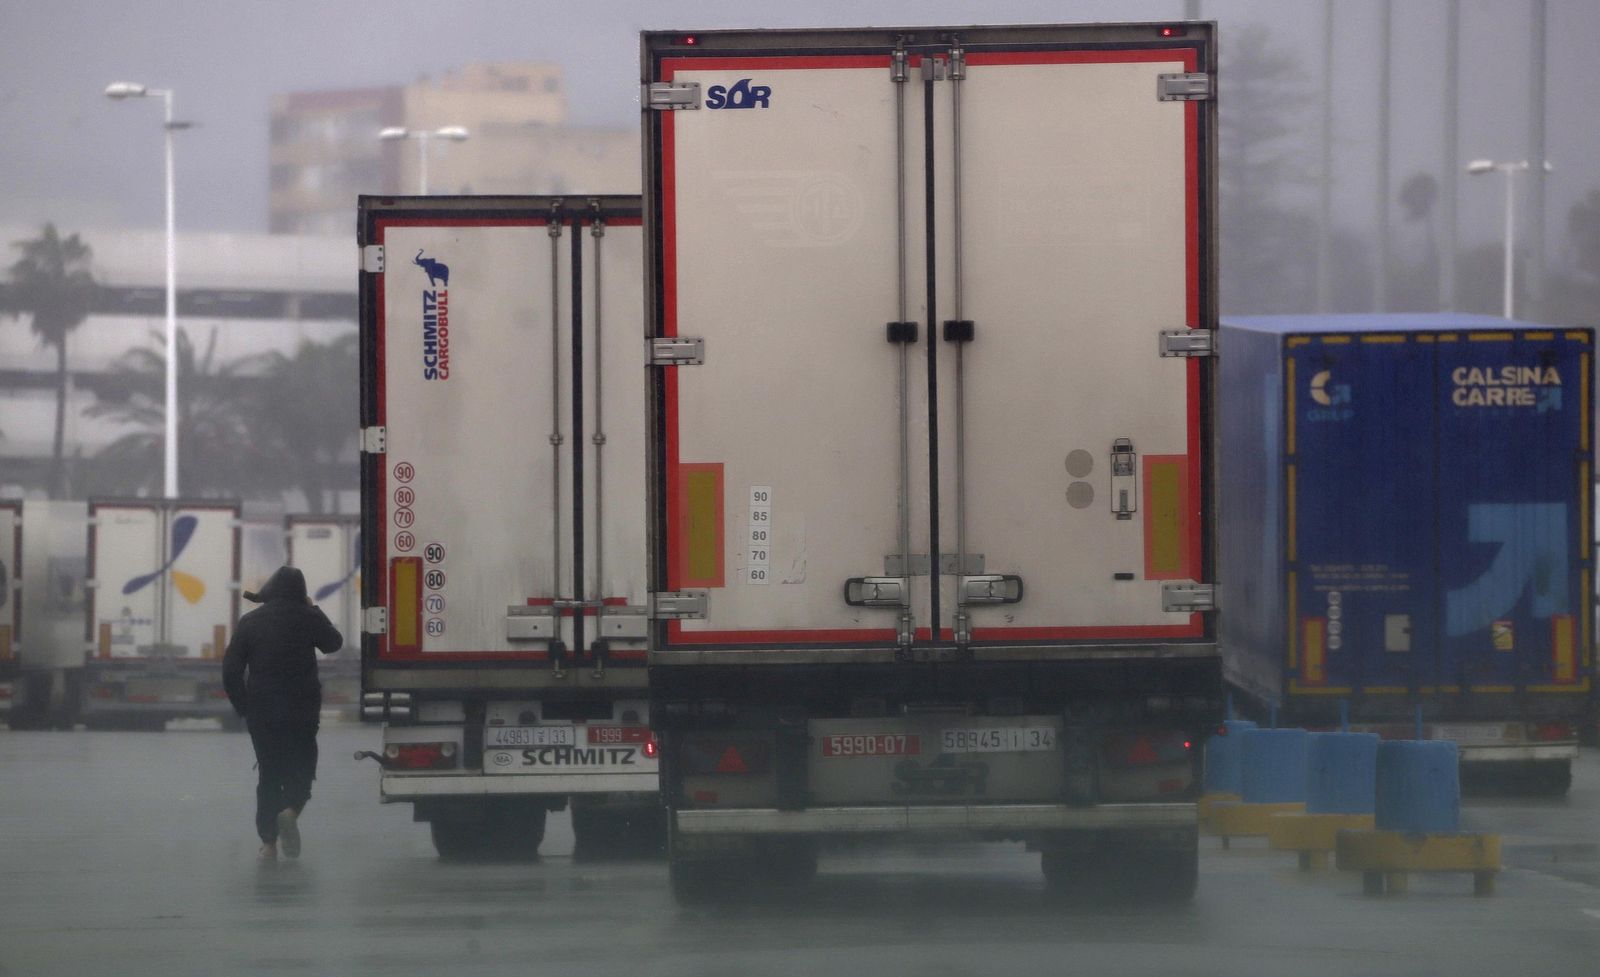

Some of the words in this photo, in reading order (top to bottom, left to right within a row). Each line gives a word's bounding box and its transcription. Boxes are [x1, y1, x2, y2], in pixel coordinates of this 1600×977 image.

[423, 290, 438, 380] SCHMITZ
[438, 289, 449, 381] CARGOBULL
[1451, 366, 1561, 385] CALSINA
[397, 466, 411, 479] 90
[397, 490, 411, 504] 80
[754, 491, 768, 502] 90
[398, 511, 411, 524] 70
[753, 511, 768, 521] 85
[398, 535, 412, 548] 60
[752, 531, 767, 541] 80
[427, 547, 442, 560] 90
[751, 550, 766, 561] 70
[428, 573, 442, 587] 80
[751, 570, 765, 580] 60
[429, 598, 443, 610] 70
[428, 621, 443, 633] 60
[552, 729, 566, 744] 33
[595, 728, 622, 743] 1999
[1030, 730, 1051, 748] 34
[831, 735, 906, 755] 5990-07
[522, 748, 636, 766] SCHMITZ
